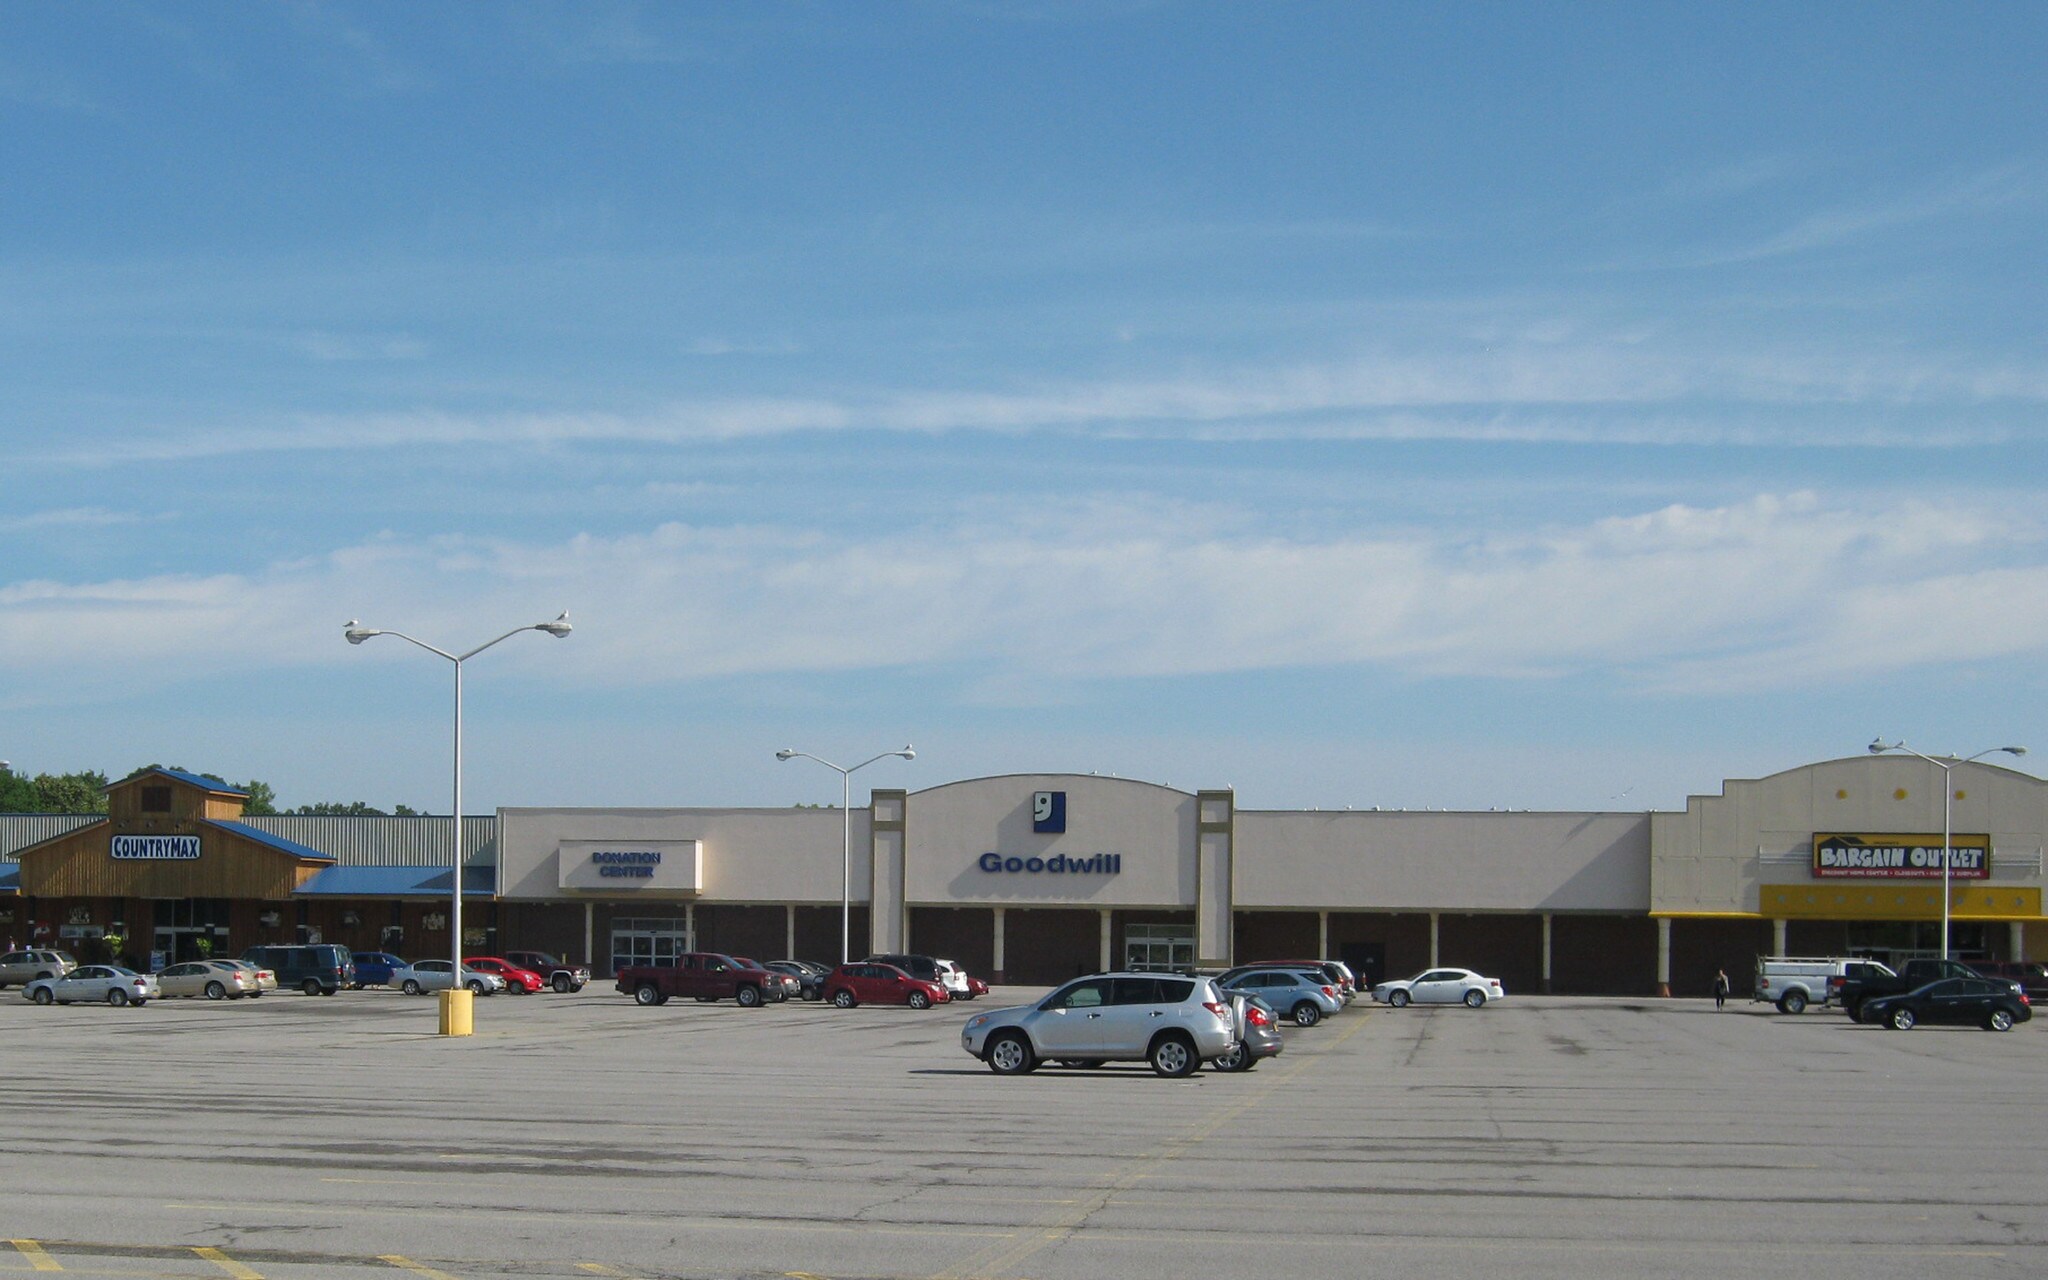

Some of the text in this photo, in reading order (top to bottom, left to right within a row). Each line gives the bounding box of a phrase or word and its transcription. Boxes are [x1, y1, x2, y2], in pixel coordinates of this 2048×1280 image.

[114, 837, 198, 858] COUNTRYMAX
[592, 852, 661, 864] DONATION
[1821, 847, 1982, 868] BARGAIN OUTLET
[600, 866, 654, 877] CENTER
[979, 852, 1121, 874] Goodwill
